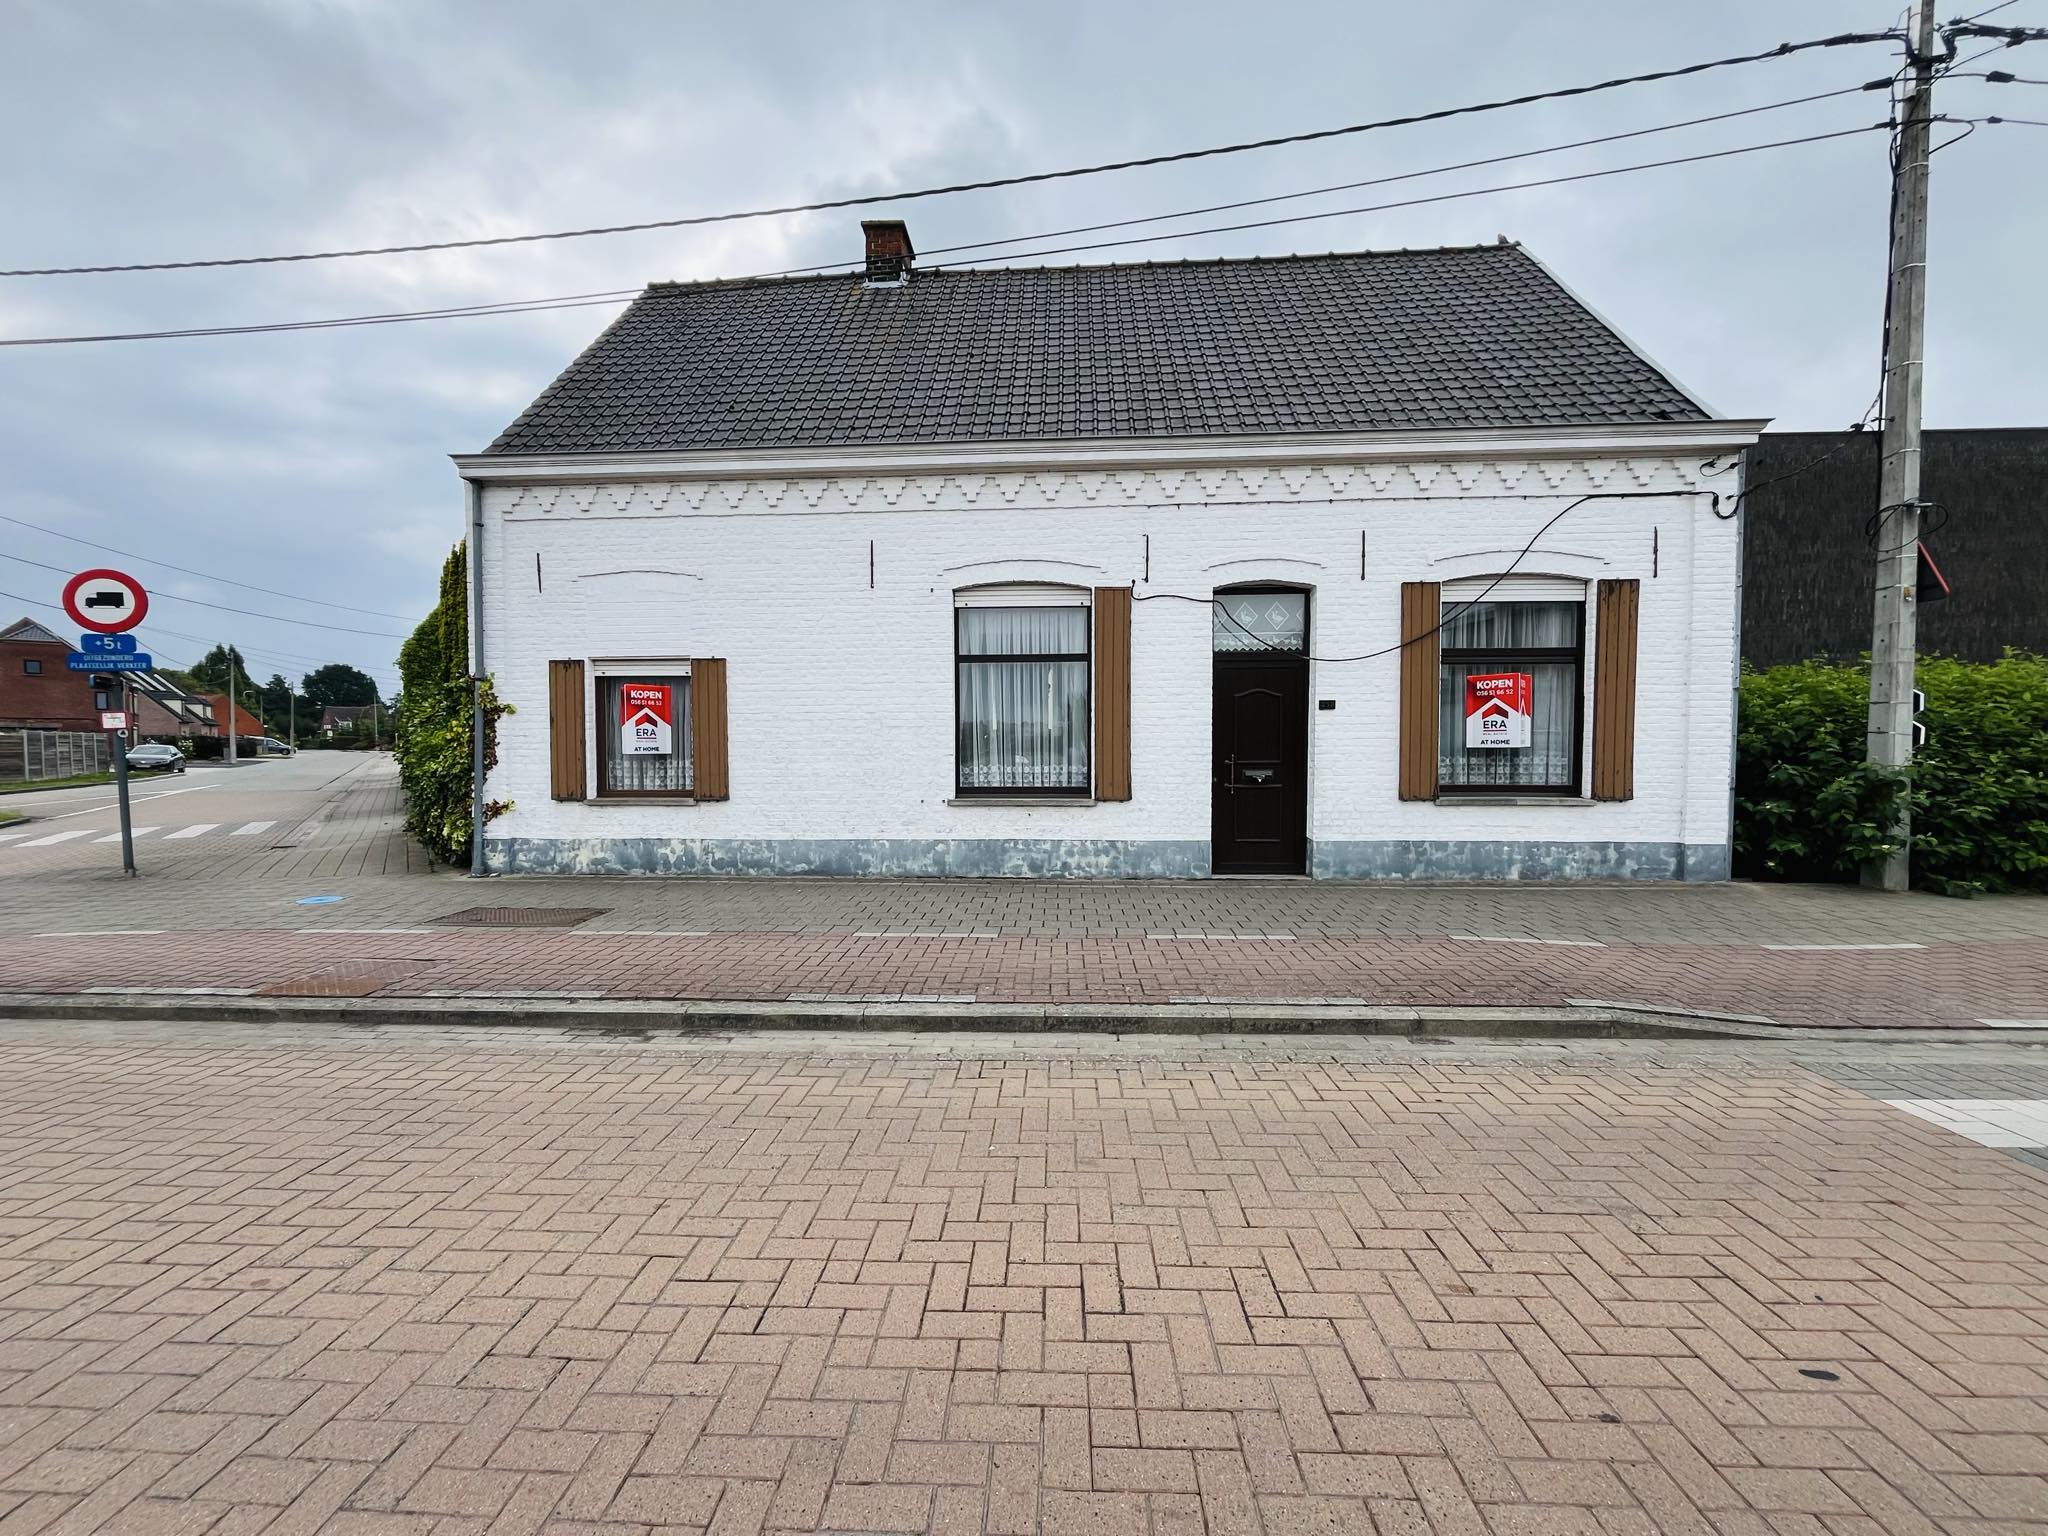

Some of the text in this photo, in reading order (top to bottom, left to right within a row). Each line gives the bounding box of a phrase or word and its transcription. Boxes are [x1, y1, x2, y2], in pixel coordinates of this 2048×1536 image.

[1476, 679, 1513, 690] KOPEN
[630, 690, 663, 699] KOPEN
[1483, 720, 1507, 729] ERA
[636, 728, 657, 737] ERA
